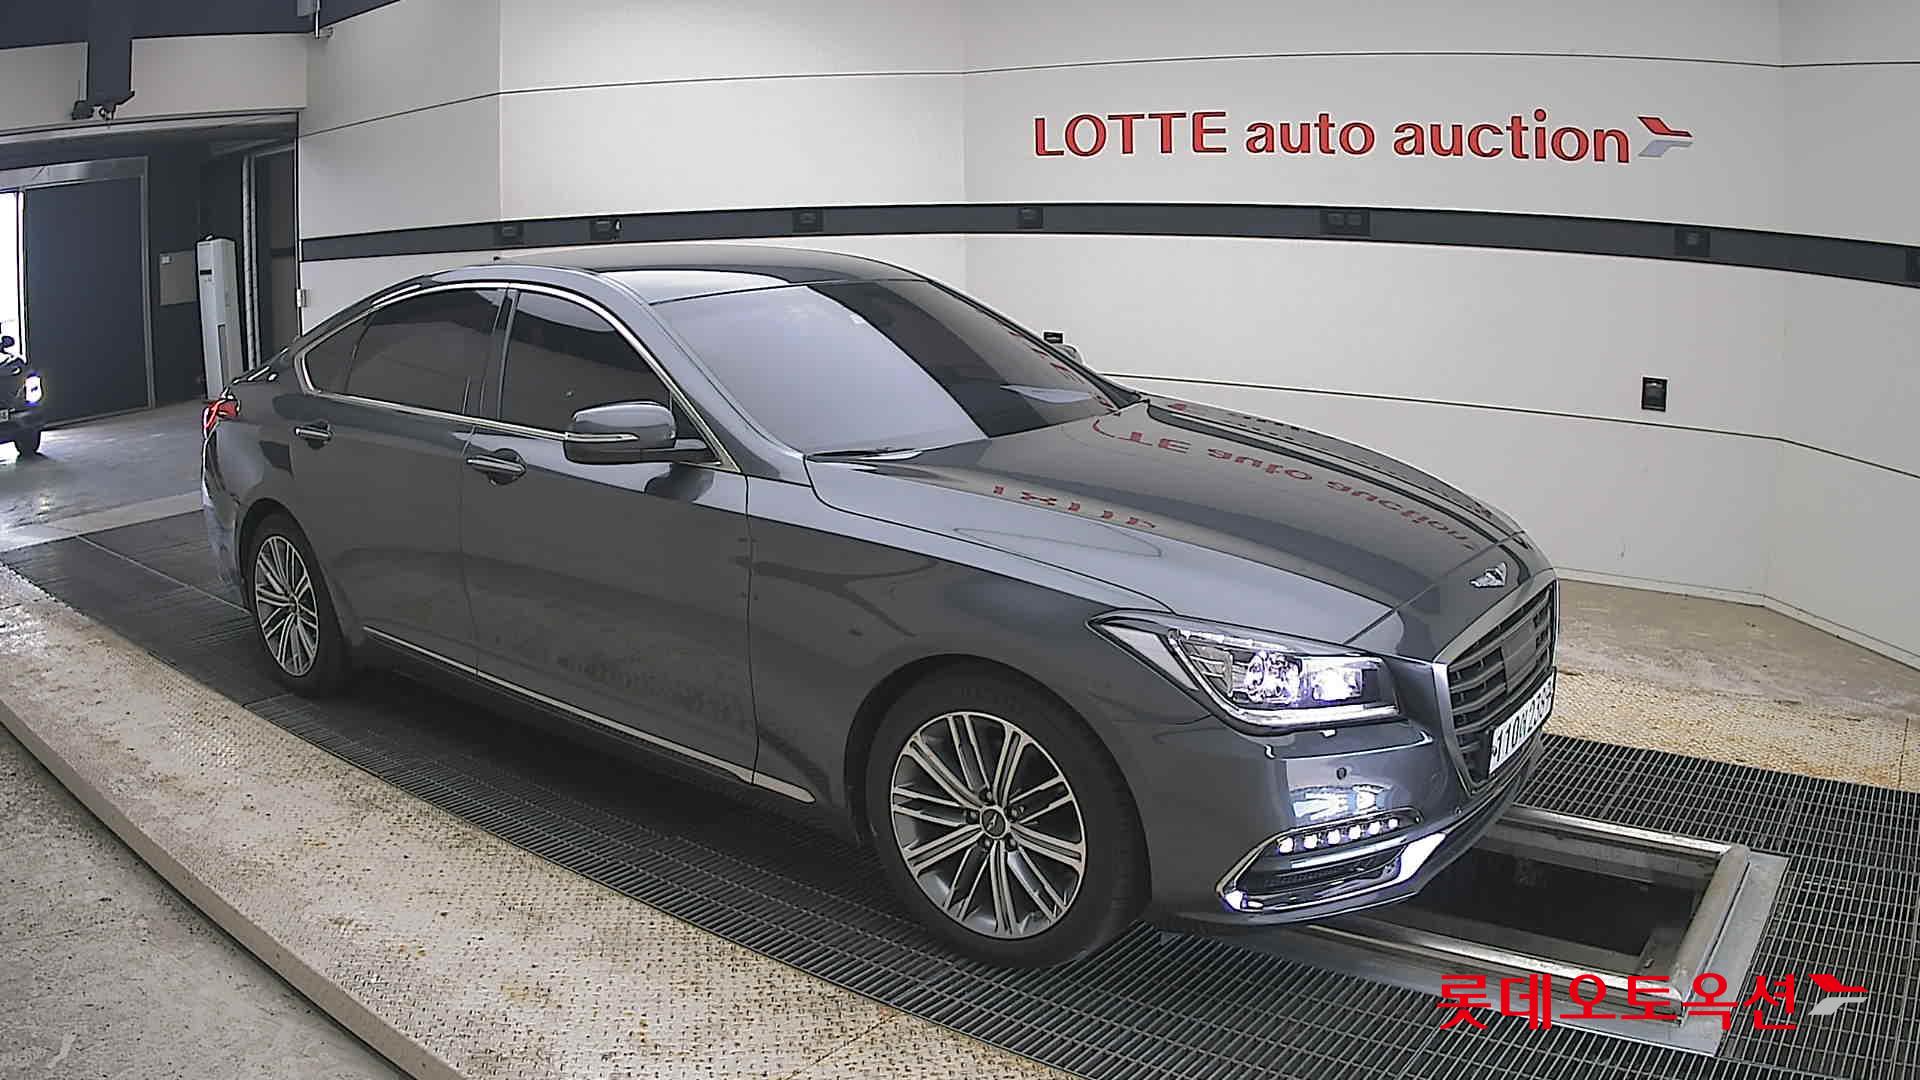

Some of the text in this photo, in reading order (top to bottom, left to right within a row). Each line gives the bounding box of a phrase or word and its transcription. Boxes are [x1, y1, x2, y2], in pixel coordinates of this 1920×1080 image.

[1034, 108, 1631, 164] LOTTE auto auction
